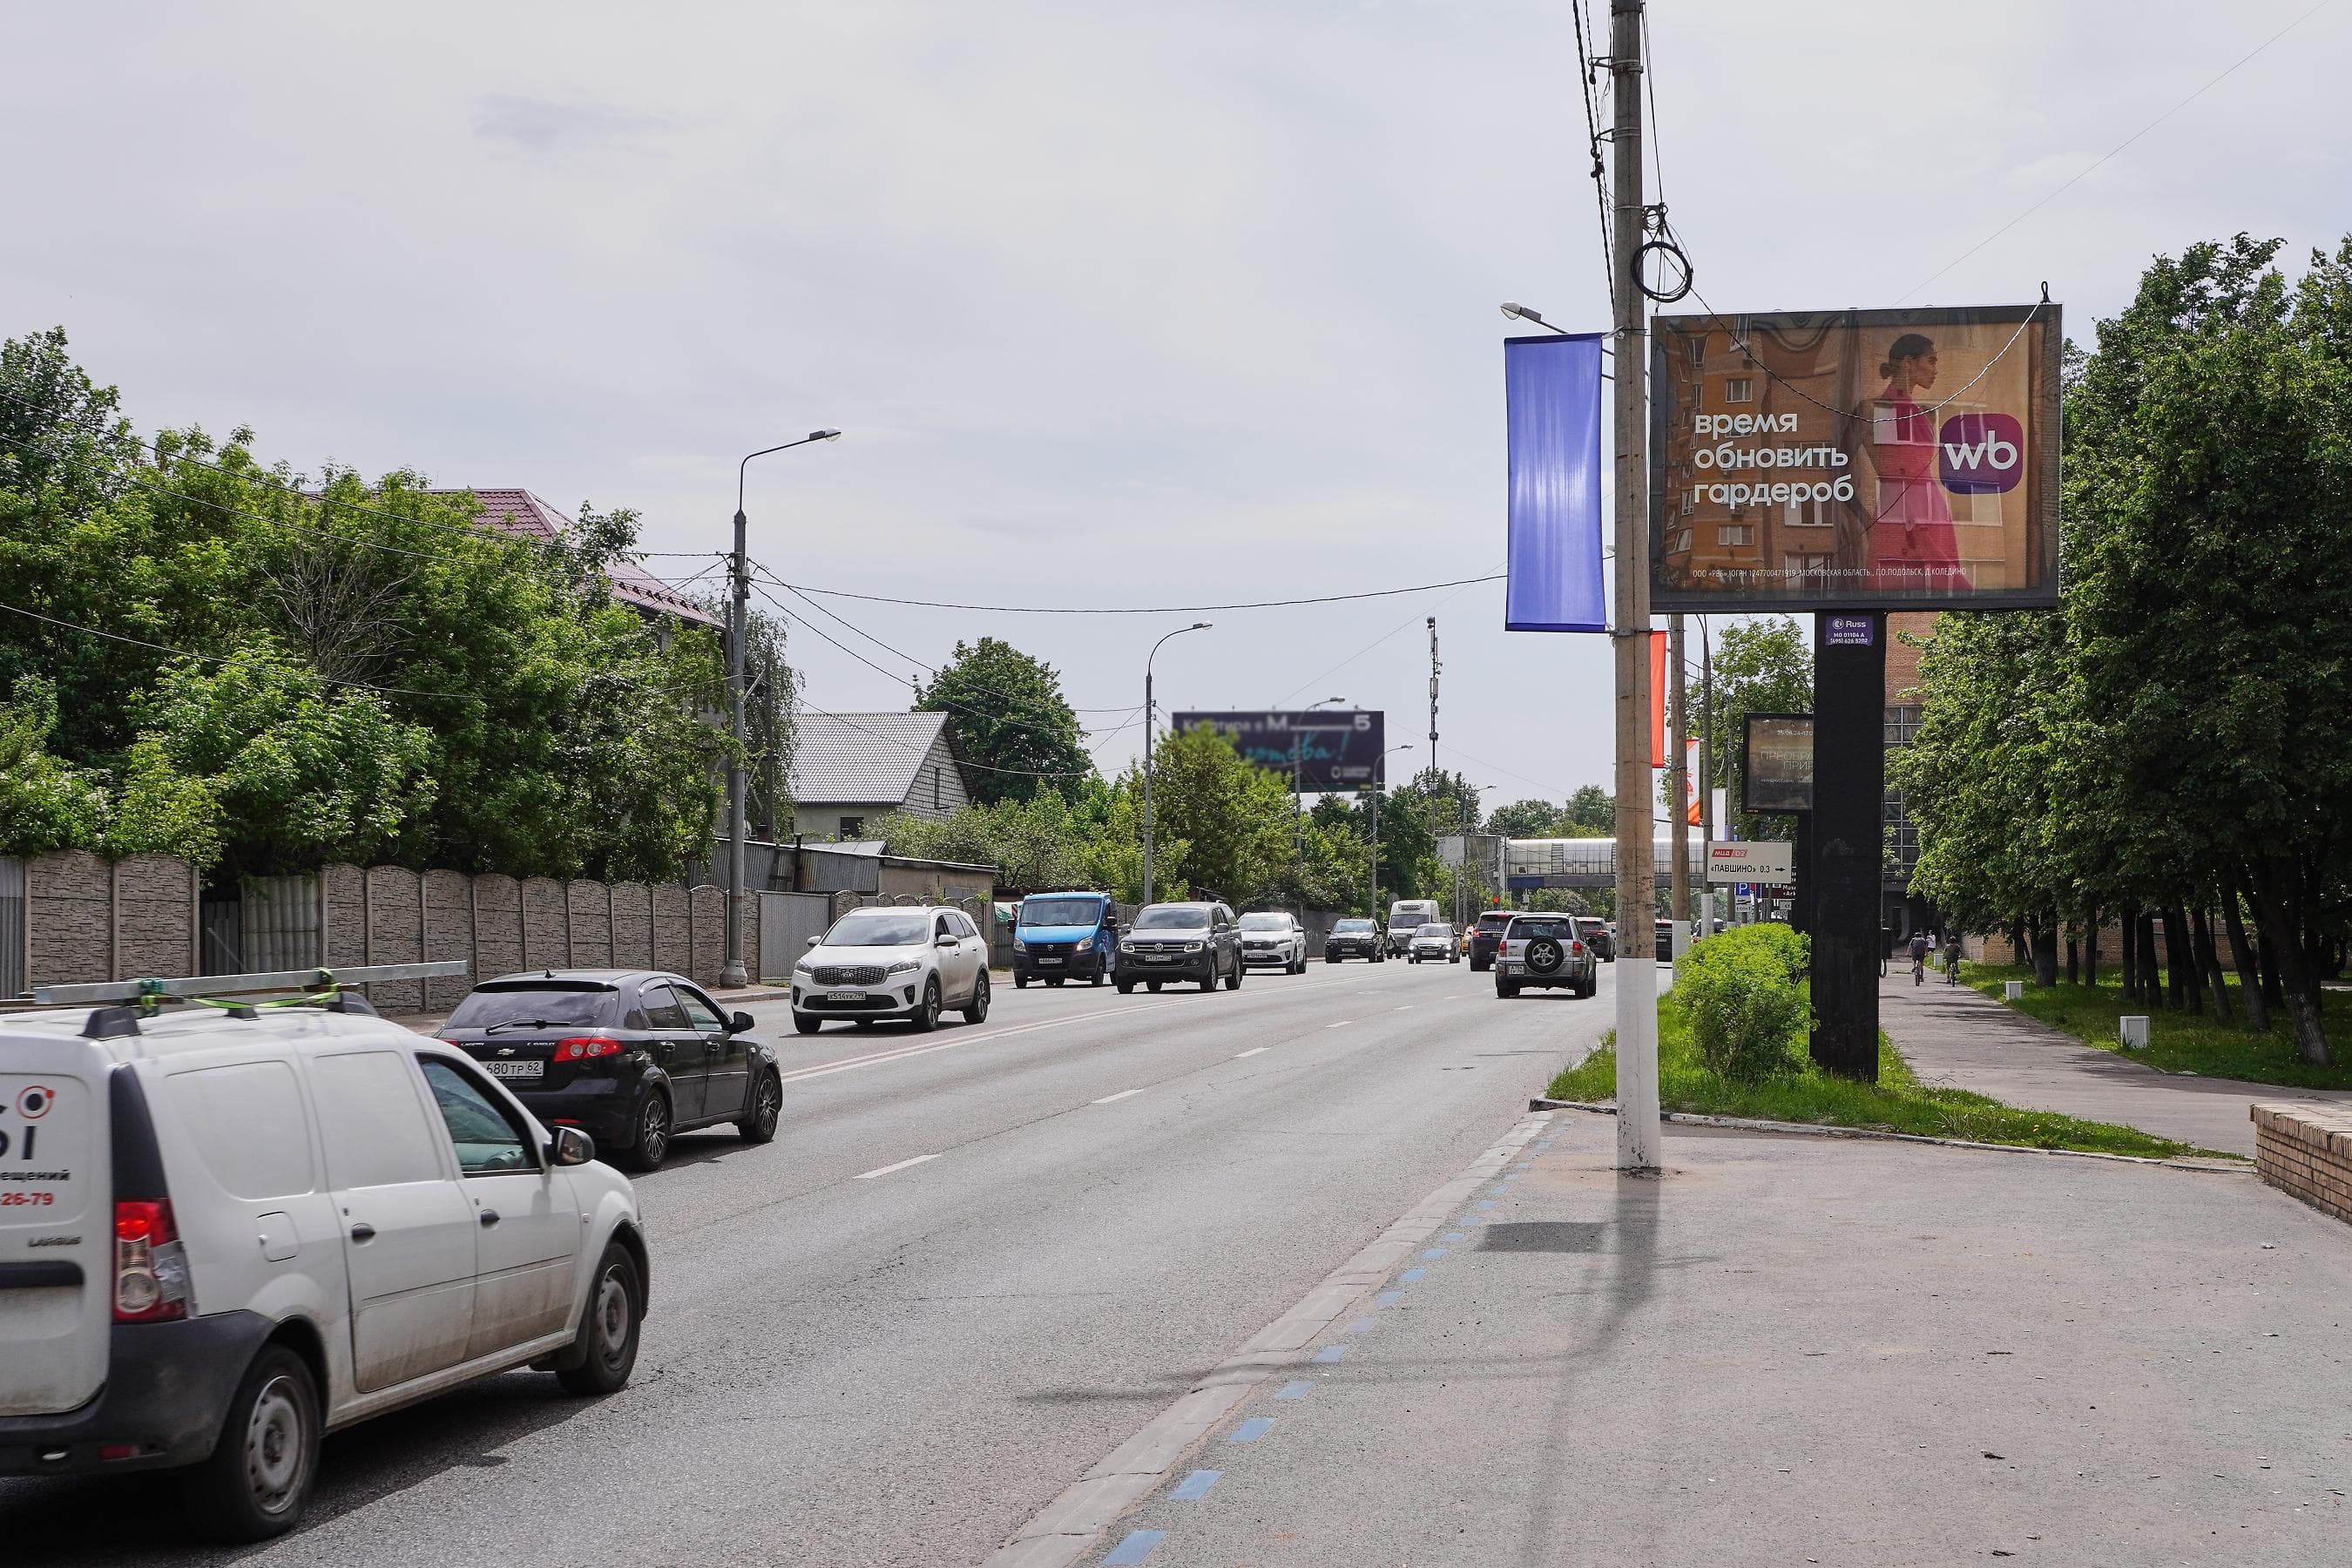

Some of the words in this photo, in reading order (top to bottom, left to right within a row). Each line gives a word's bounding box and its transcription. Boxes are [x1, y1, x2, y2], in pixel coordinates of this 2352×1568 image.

[1695, 413, 1798, 440] время
[1694, 441, 1848, 469] обновить
[1944, 429, 2017, 470] wb
[1694, 474, 1855, 510] гардероб
[1693, 569, 1707, 578] ООО
[1799, 568, 1842, 577] МОСКОВСКАЯ
[1710, 864, 1756, 873] «ПАВШИНО»
[1760, 865, 1771, 874] 0.3
[0, 1192, 55, 1206] 26-79
